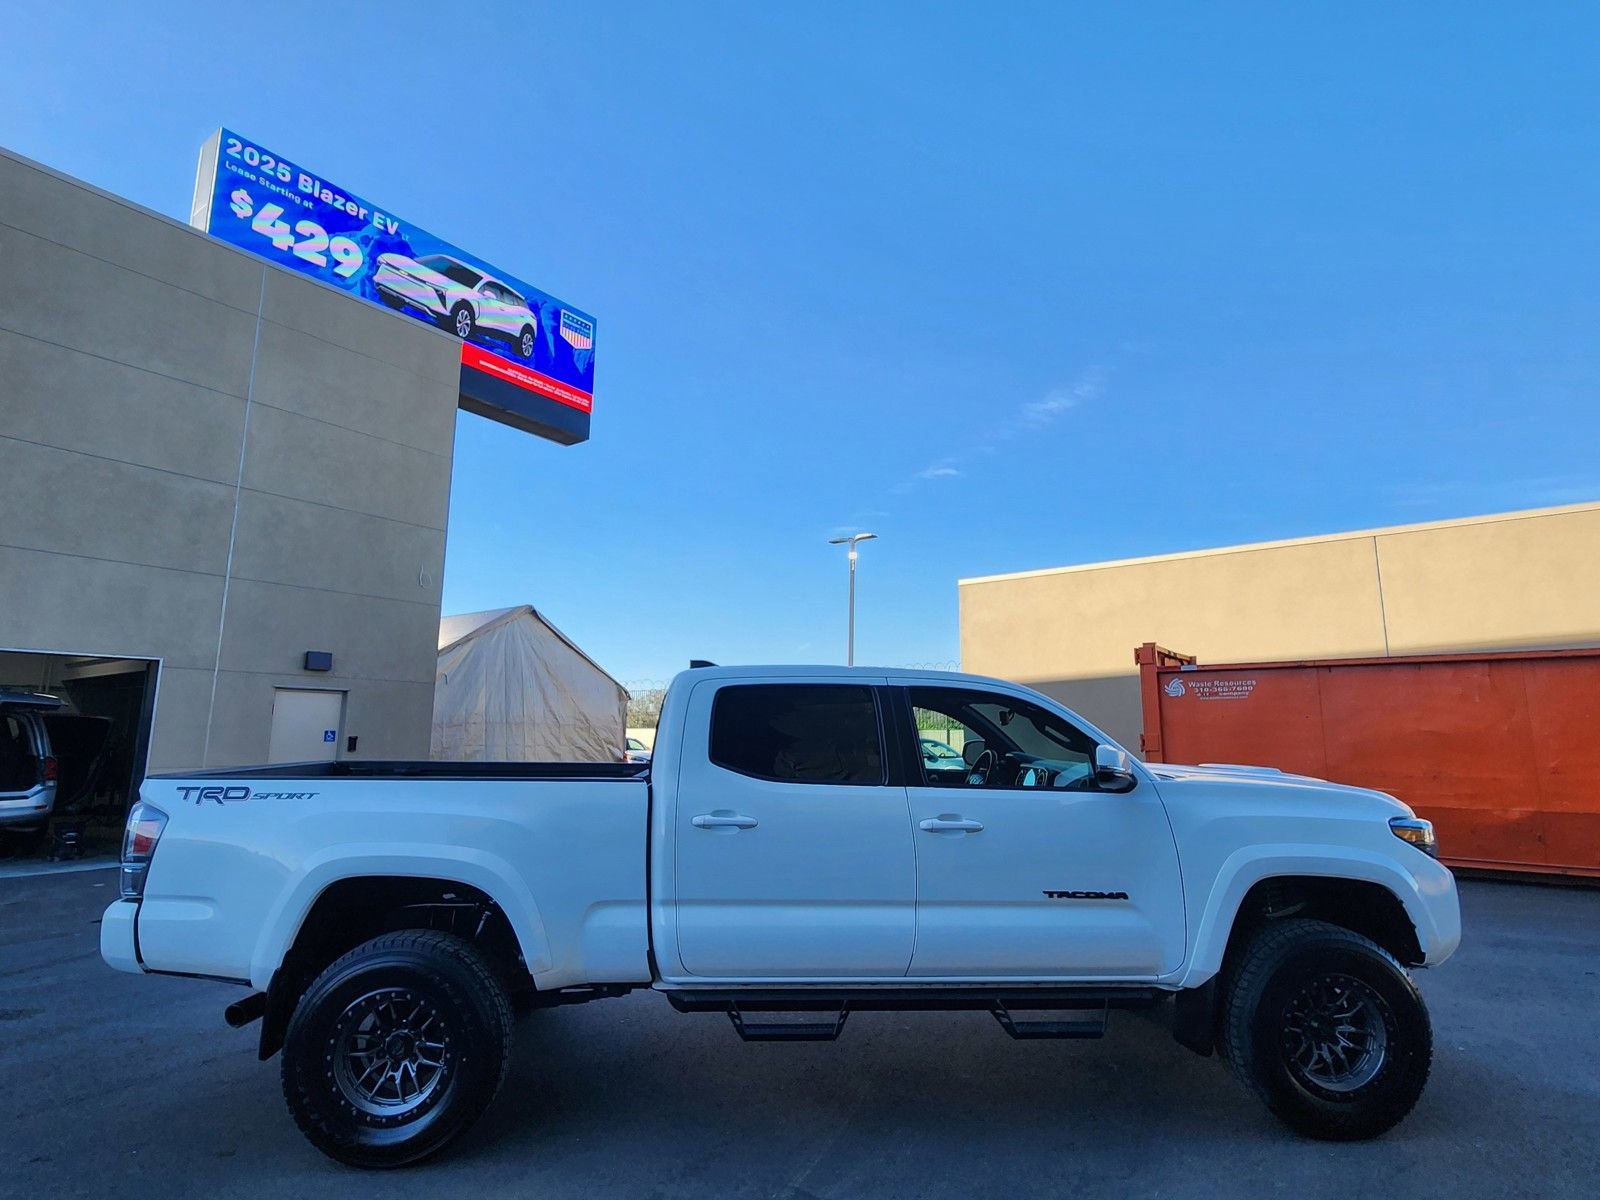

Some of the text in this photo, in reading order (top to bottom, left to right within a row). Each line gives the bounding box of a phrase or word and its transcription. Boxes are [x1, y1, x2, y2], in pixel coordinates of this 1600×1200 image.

[225, 161, 314, 210] Lease Starting at
[226, 137, 399, 235] 2025 Blazer EV
[230, 188, 363, 278] $429
[176, 786, 320, 805] TRD SPORT
[1042, 890, 1129, 900] TACOMA
